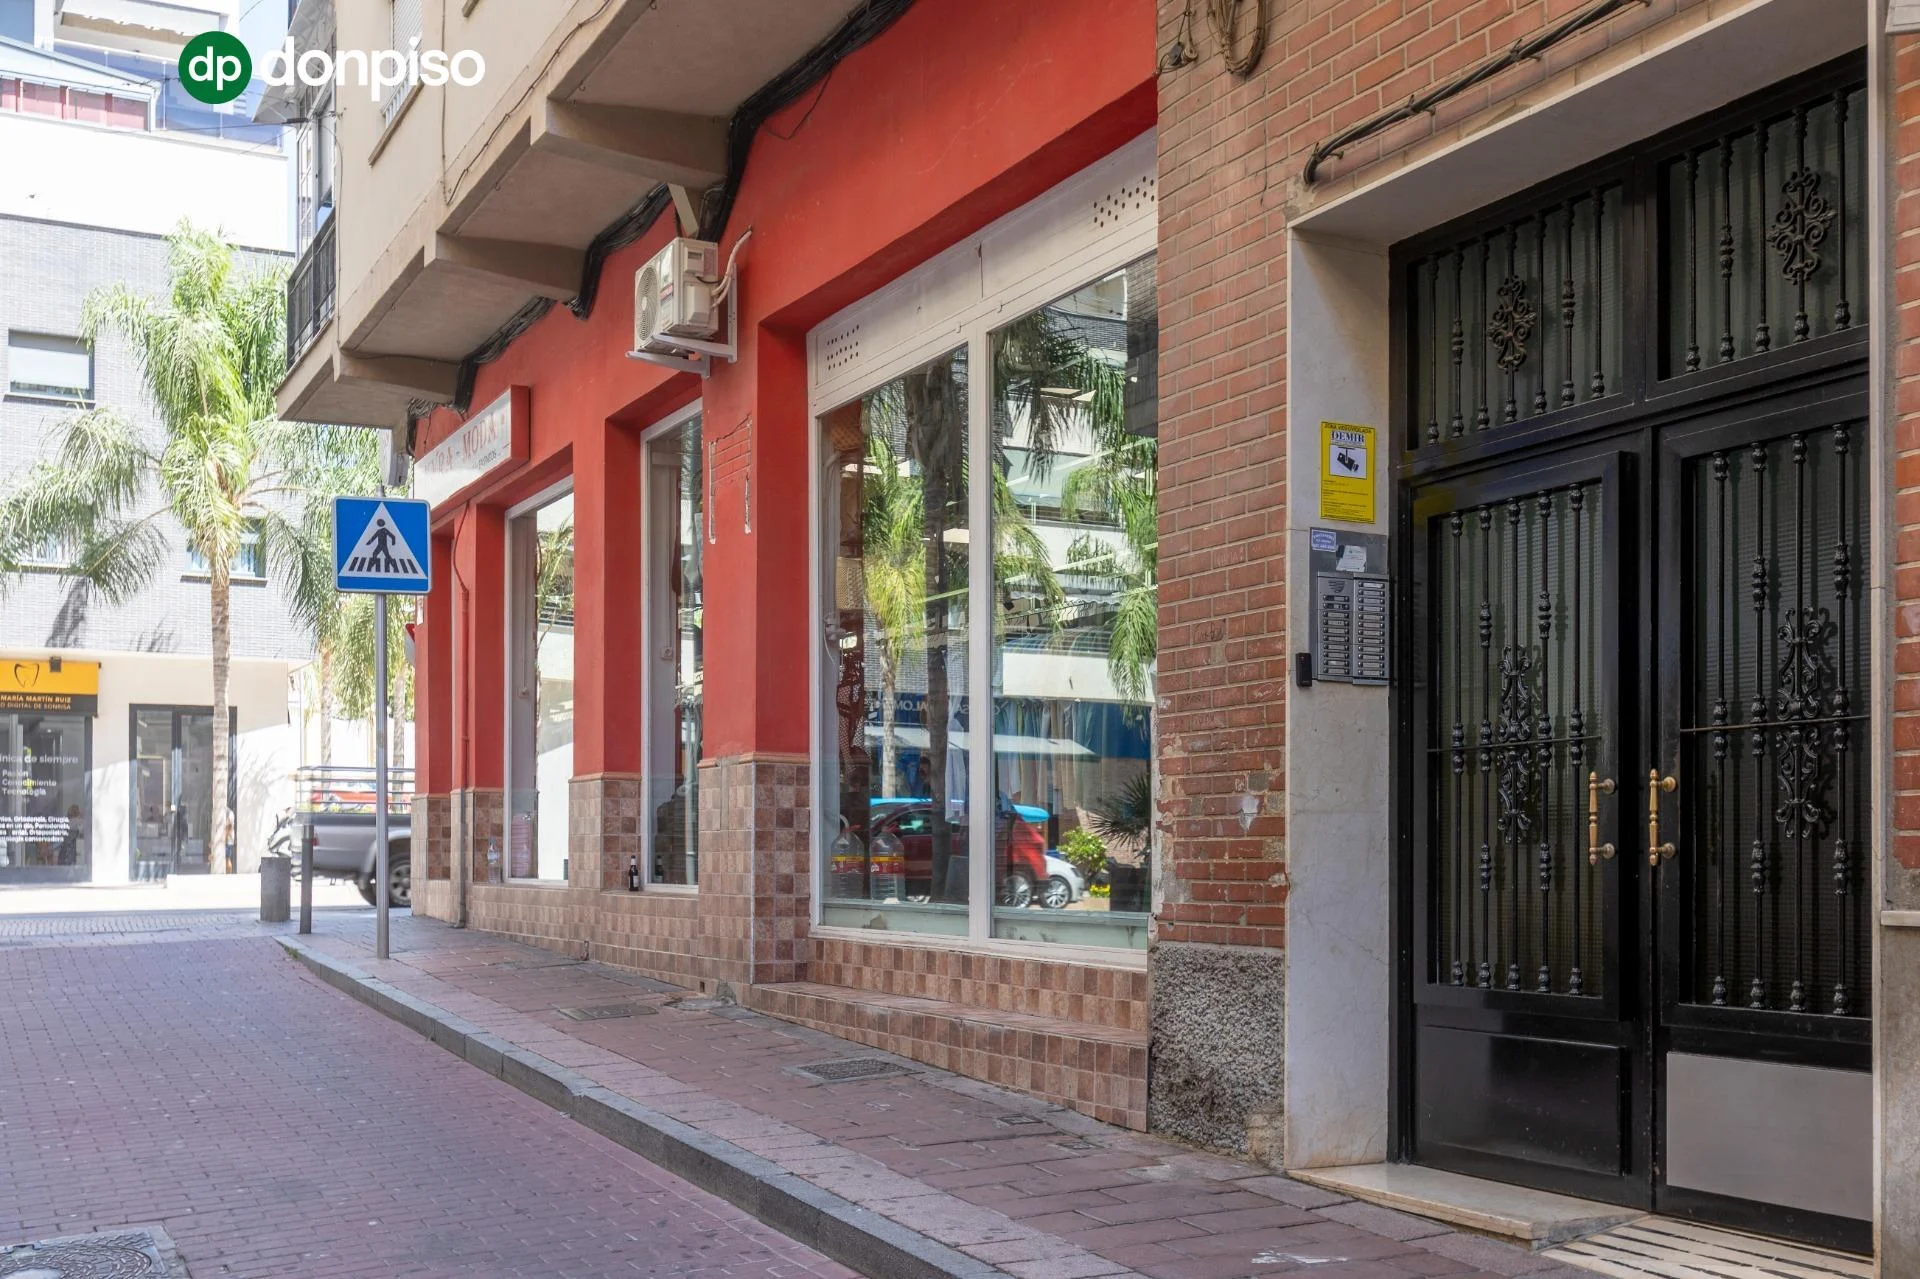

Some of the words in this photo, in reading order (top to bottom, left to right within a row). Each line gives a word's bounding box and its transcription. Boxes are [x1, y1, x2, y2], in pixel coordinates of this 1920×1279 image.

[1331, 431, 1364, 443] DEMIR
[0, 694, 24, 702] MARÍA
[26, 695, 53, 703] MARTÍN
[55, 696, 72, 704] RUIZ
[8, 702, 31, 710] DIGITAL
[24, 753, 38, 764] de
[39, 753, 79, 766] siempre
